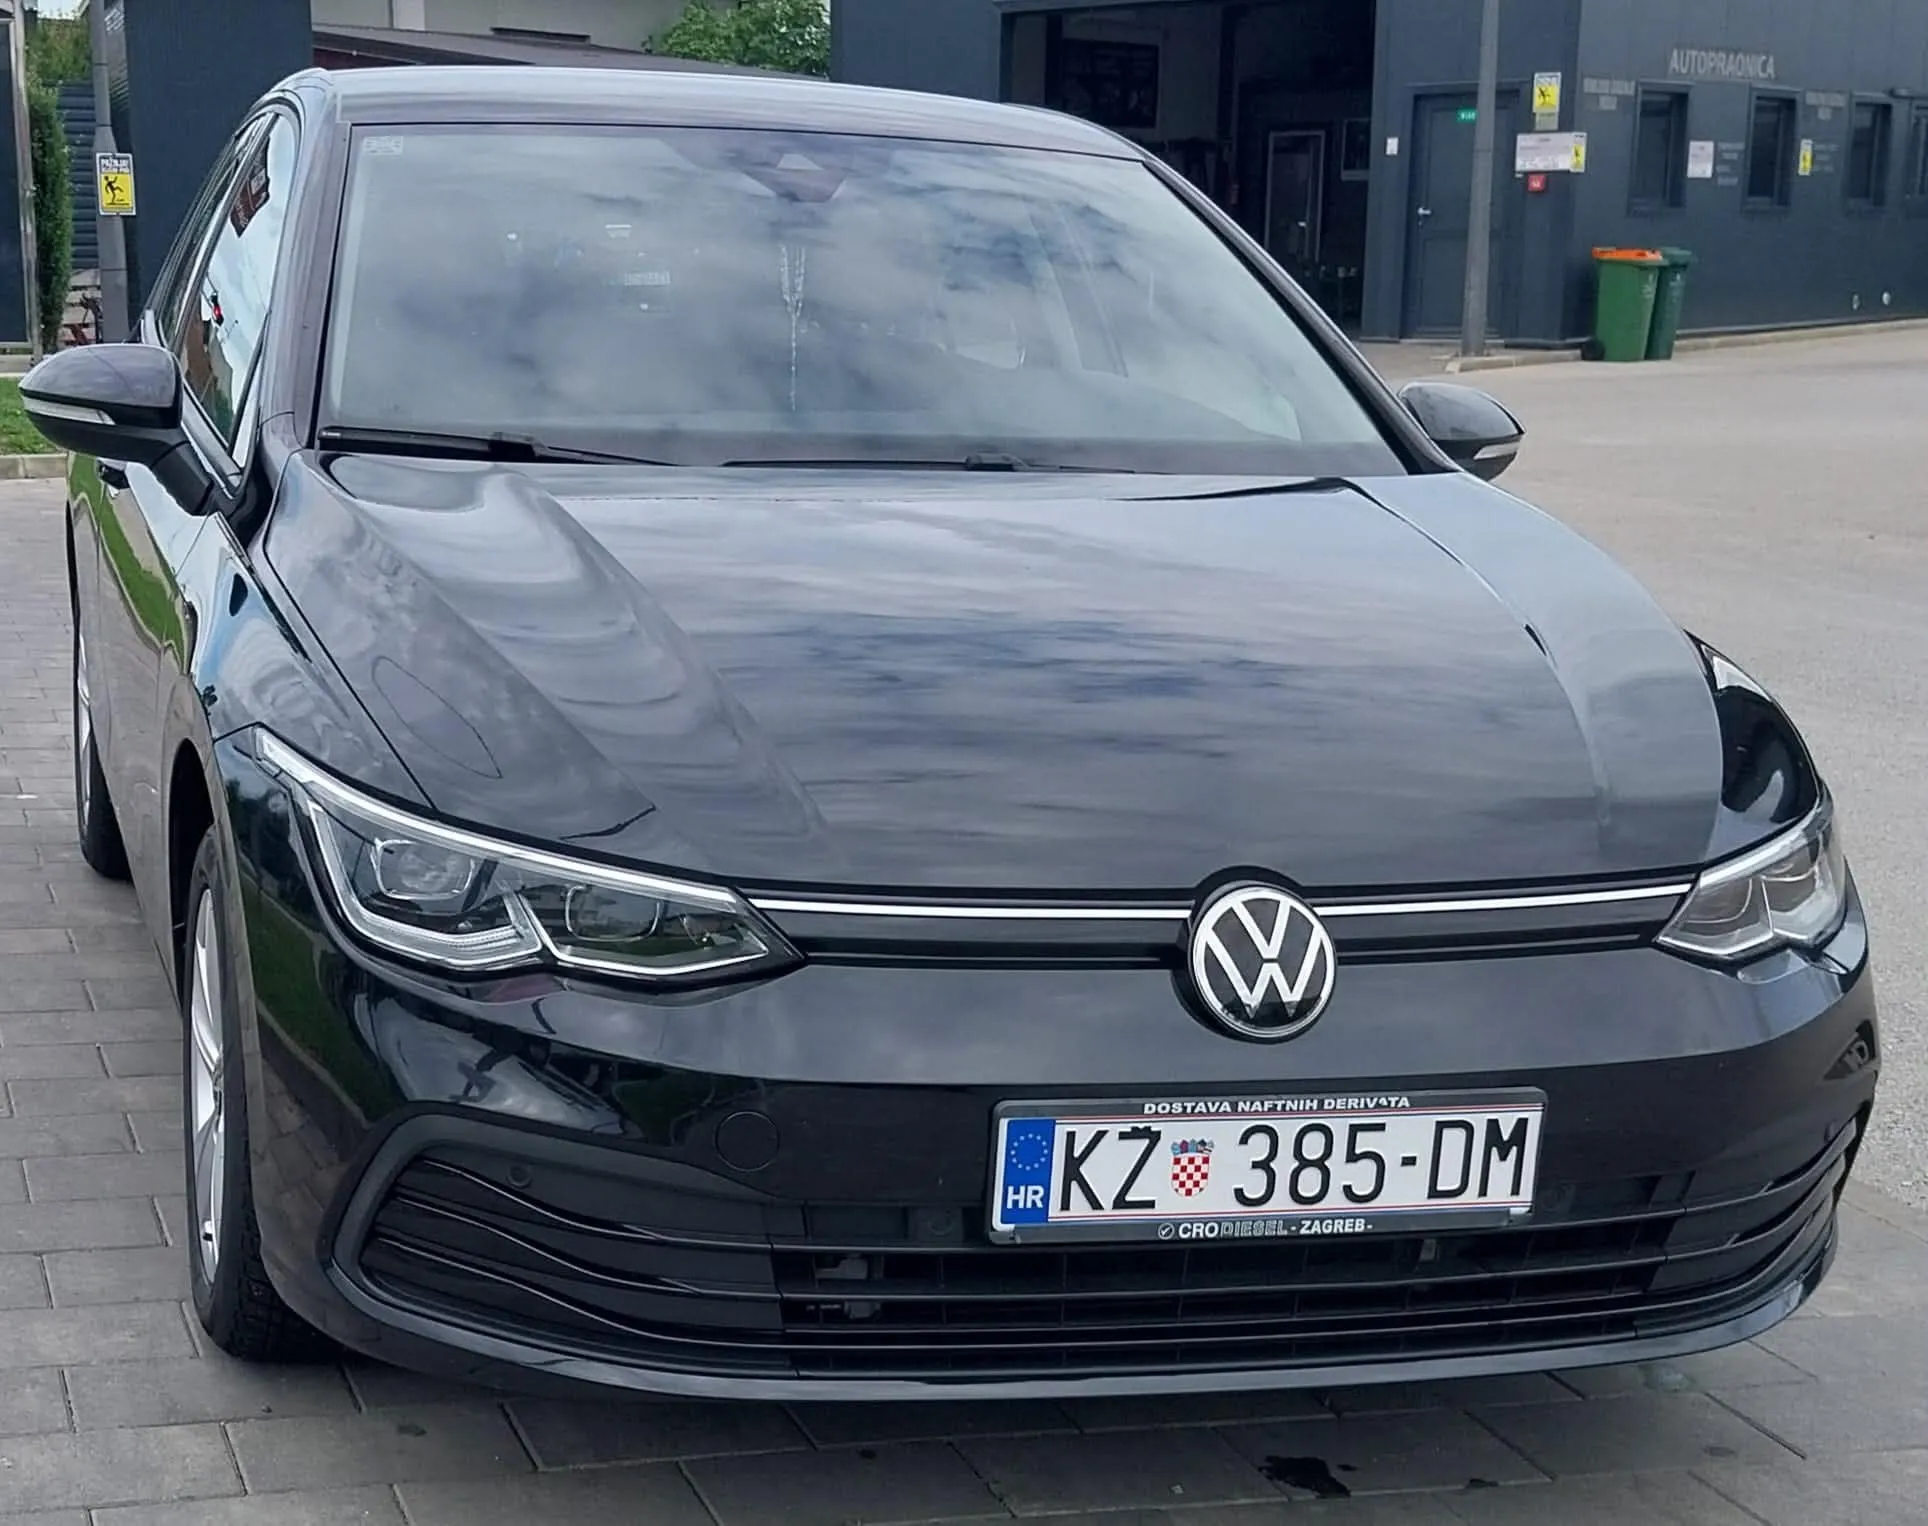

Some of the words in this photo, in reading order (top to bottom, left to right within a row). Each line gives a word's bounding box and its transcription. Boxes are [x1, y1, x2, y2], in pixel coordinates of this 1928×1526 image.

[1668, 48, 1775, 79] AUTOPRAONICA
[1144, 1101, 1232, 1114] DOSTAVA
[1237, 1098, 1318, 1112] NAFTNIH
[1060, 1126, 1162, 1211] KŽ
[1233, 1117, 1529, 1207] 385-DM
[1006, 1185, 1045, 1209] HR
